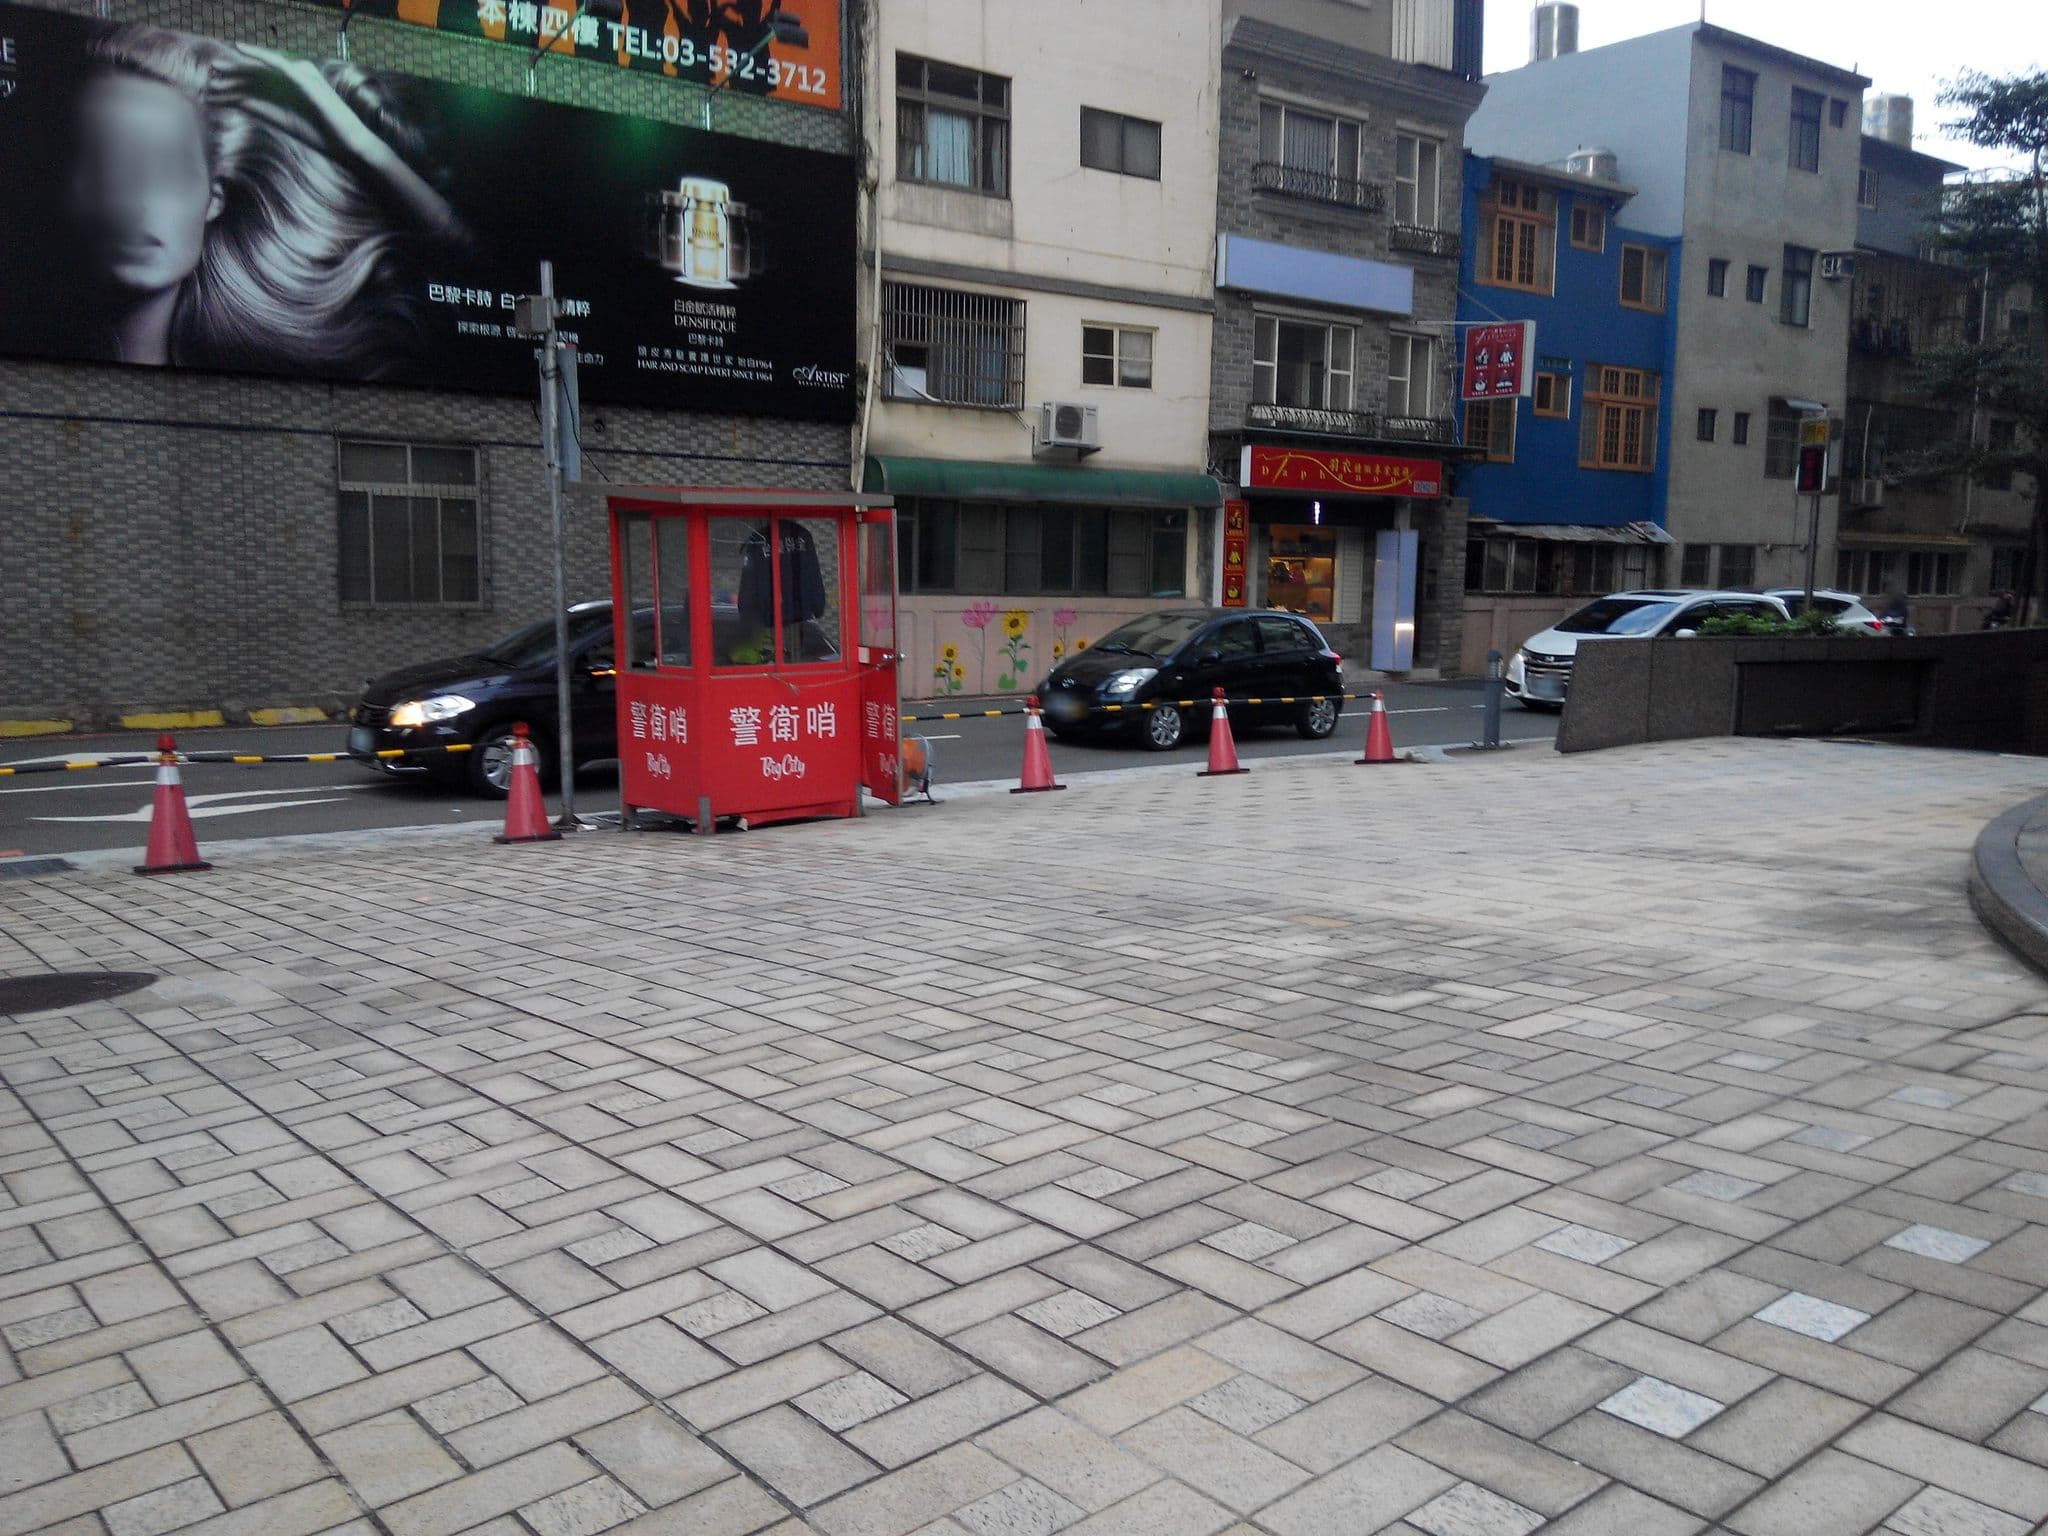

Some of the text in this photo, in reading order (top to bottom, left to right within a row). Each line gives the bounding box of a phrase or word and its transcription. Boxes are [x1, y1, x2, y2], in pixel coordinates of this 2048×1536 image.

[429, 283, 492, 309] 巴黎卡詩
[637, 359, 658, 370] HAIR
[659, 361, 679, 372] AND
[679, 363, 704, 375] SCALP
[631, 700, 688, 745] 警衛哨
[730, 701, 836, 747] 警衛哨
